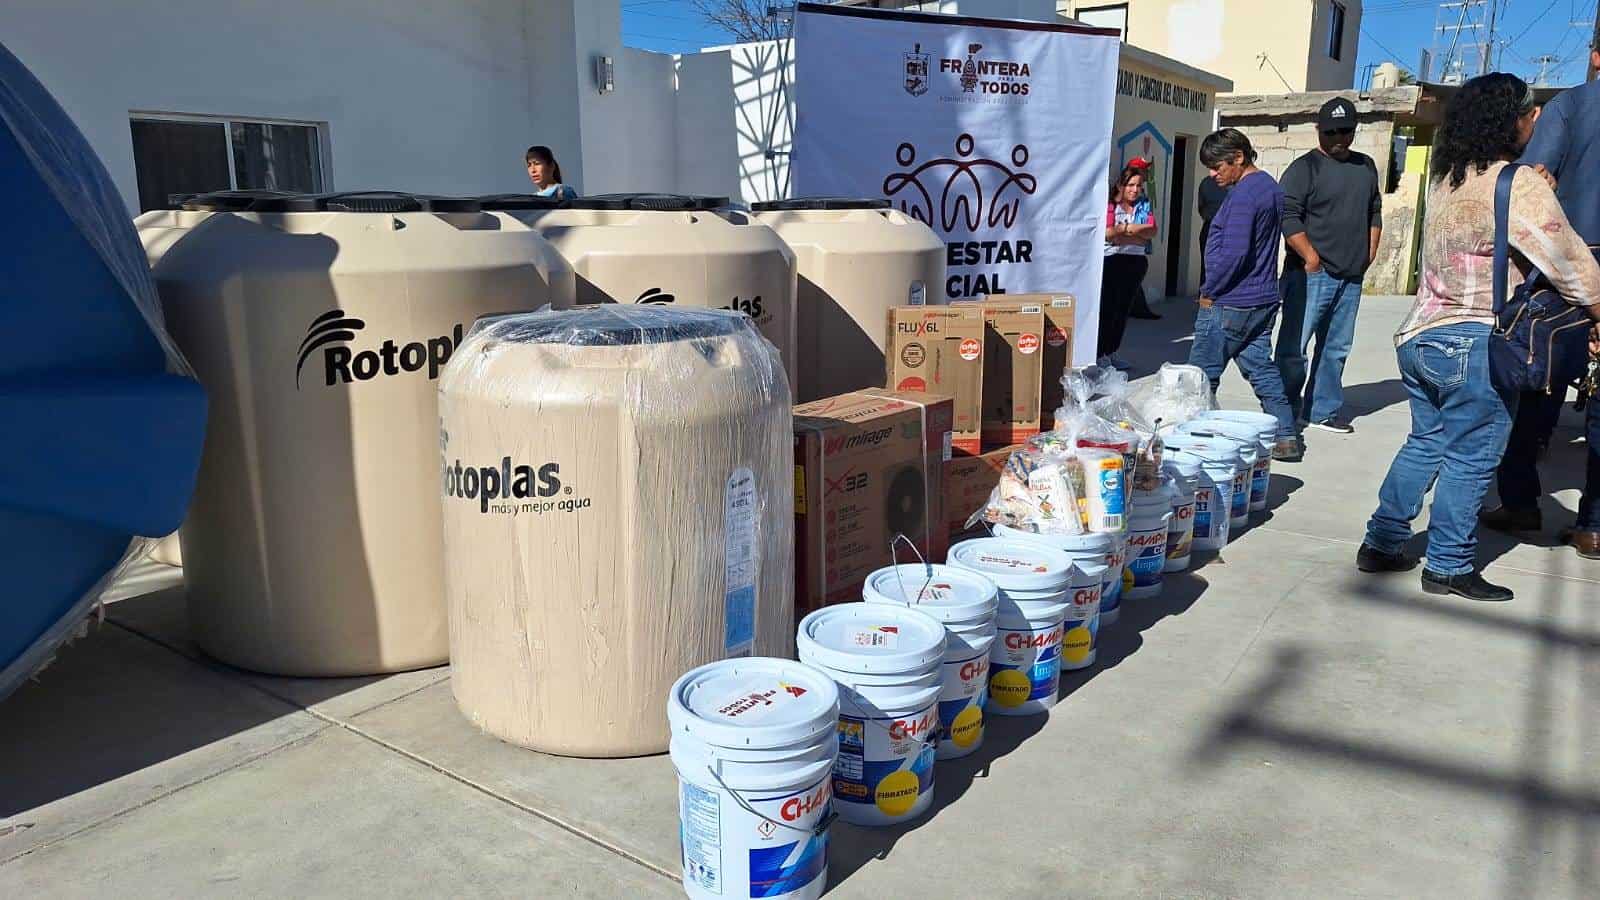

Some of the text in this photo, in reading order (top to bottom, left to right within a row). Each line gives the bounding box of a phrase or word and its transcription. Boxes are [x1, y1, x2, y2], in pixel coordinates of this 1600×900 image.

[980, 81, 1029, 95] TODOS
[946, 240, 1032, 266] ESTAR
[946, 273, 1006, 298] CIAL
[325, 324, 463, 386] Rotopl
[847, 427, 892, 448] mirage
[444, 456, 561, 513] otoplas
[492, 498, 591, 516] más y mejor agua
